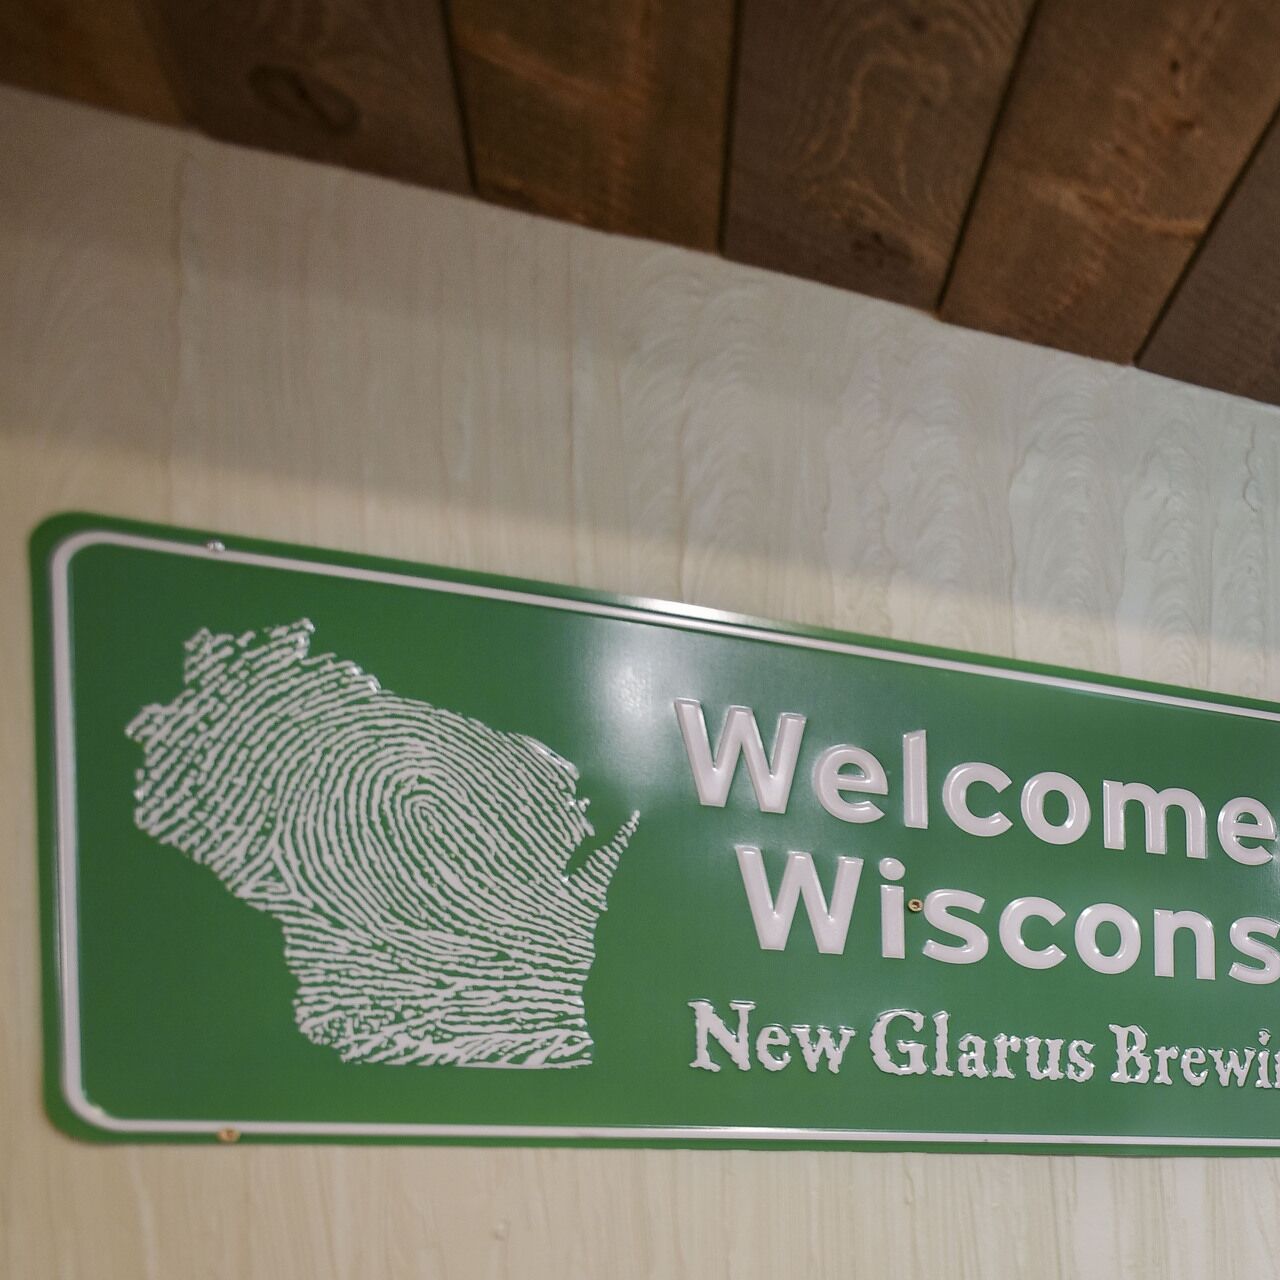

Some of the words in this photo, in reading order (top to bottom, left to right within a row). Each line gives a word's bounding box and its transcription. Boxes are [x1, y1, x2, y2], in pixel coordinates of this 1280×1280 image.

[673, 697, 1278, 867] Welcome
[688, 998, 856, 1075] New
[869, 1008, 1097, 1083] Glarus
